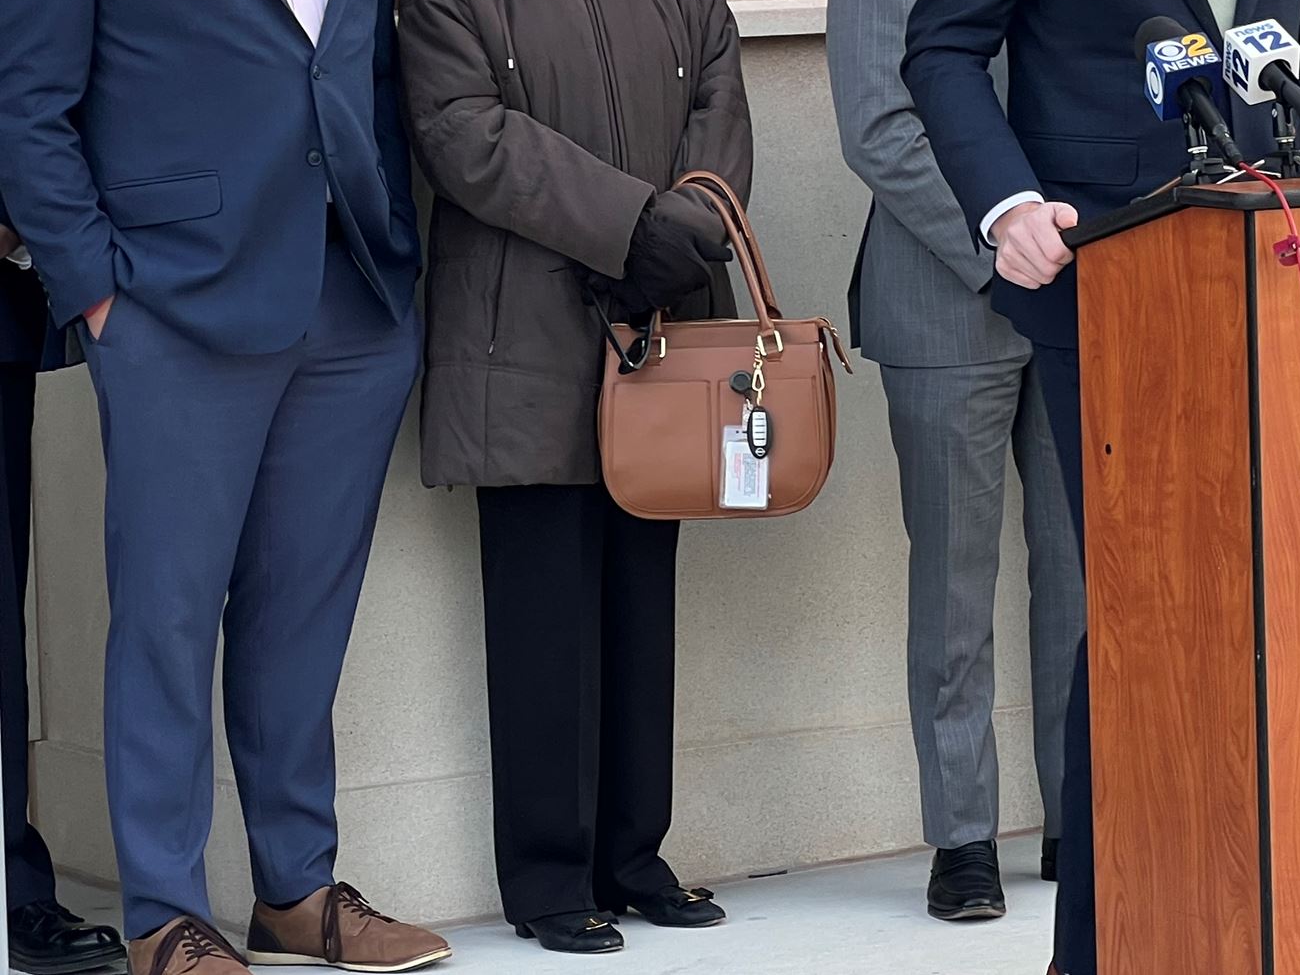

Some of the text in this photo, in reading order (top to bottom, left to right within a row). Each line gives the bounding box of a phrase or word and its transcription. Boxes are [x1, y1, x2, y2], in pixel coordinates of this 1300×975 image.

[1234, 22, 1274, 37] news
[1181, 33, 1213, 57] 2
[1242, 30, 1292, 53] 12
[1162, 53, 1219, 72] NEWS
[1224, 40, 1233, 80] news
[1232, 48, 1250, 92] 12
